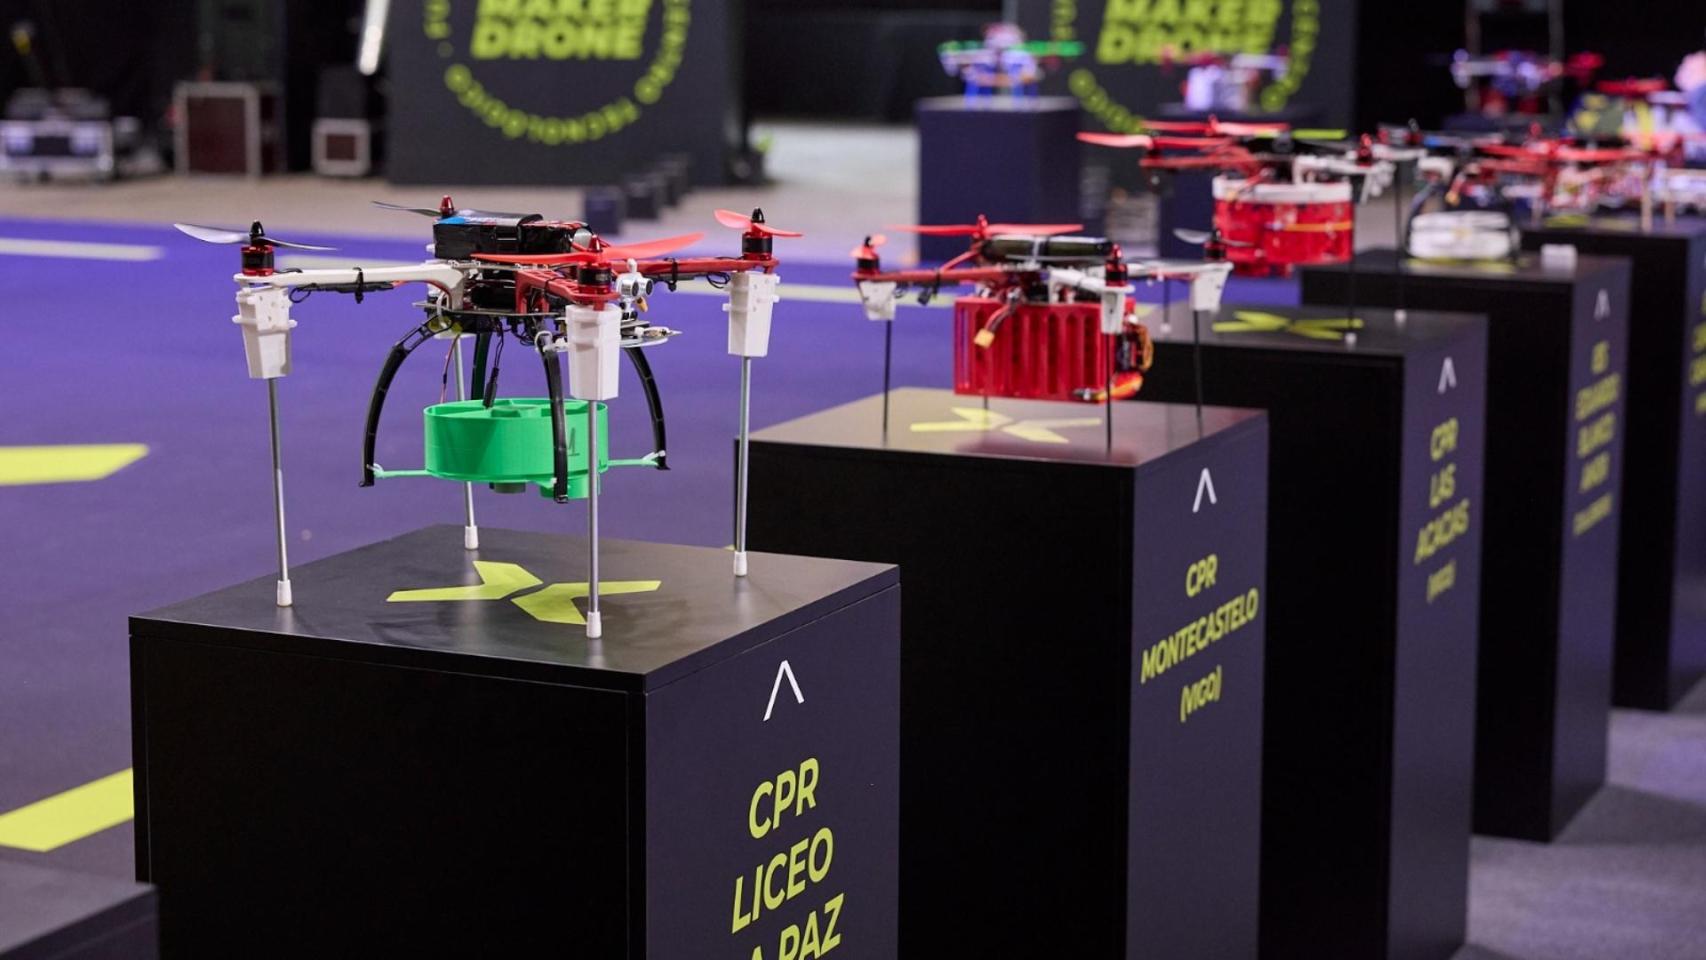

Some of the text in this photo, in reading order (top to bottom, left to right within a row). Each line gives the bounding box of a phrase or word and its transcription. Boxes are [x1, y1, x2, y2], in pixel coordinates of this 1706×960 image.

[471, 20, 643, 59] DRONE
[1186, 554, 1218, 598] CPR
[1141, 588, 1259, 684] MONTECASTELO
[749, 757, 819, 839] CPR
[732, 827, 834, 934] LICEO
[779, 893, 844, 960] PAZ
